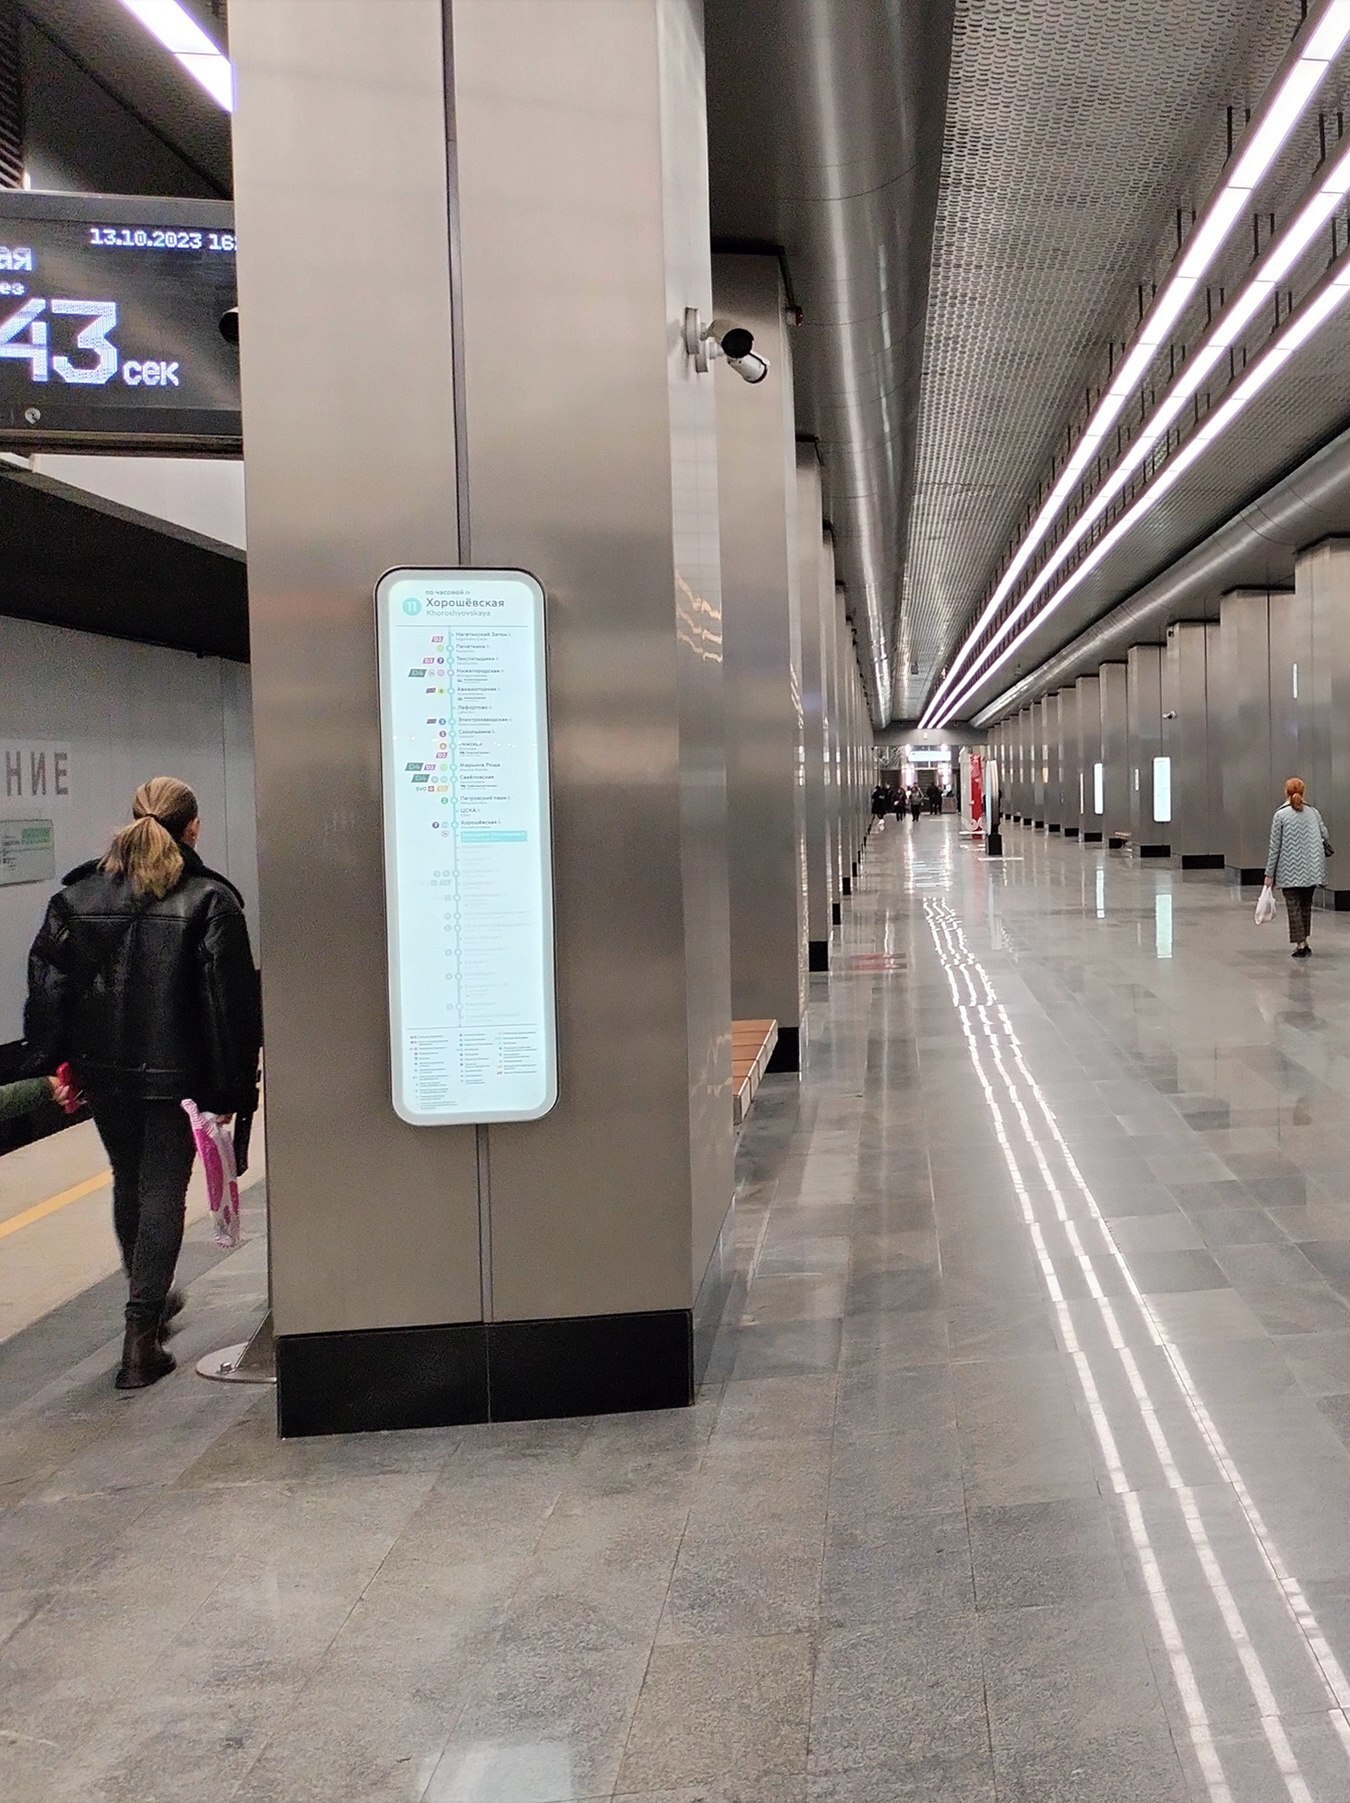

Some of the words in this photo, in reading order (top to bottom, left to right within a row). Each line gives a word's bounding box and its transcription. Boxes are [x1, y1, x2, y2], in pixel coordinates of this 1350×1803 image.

[90, 228, 202, 249] 13.10.2023
[123, 360, 179, 386] сек
[426, 598, 505, 608] Хорошёвская
[5, 751, 69, 796] НИЕ
